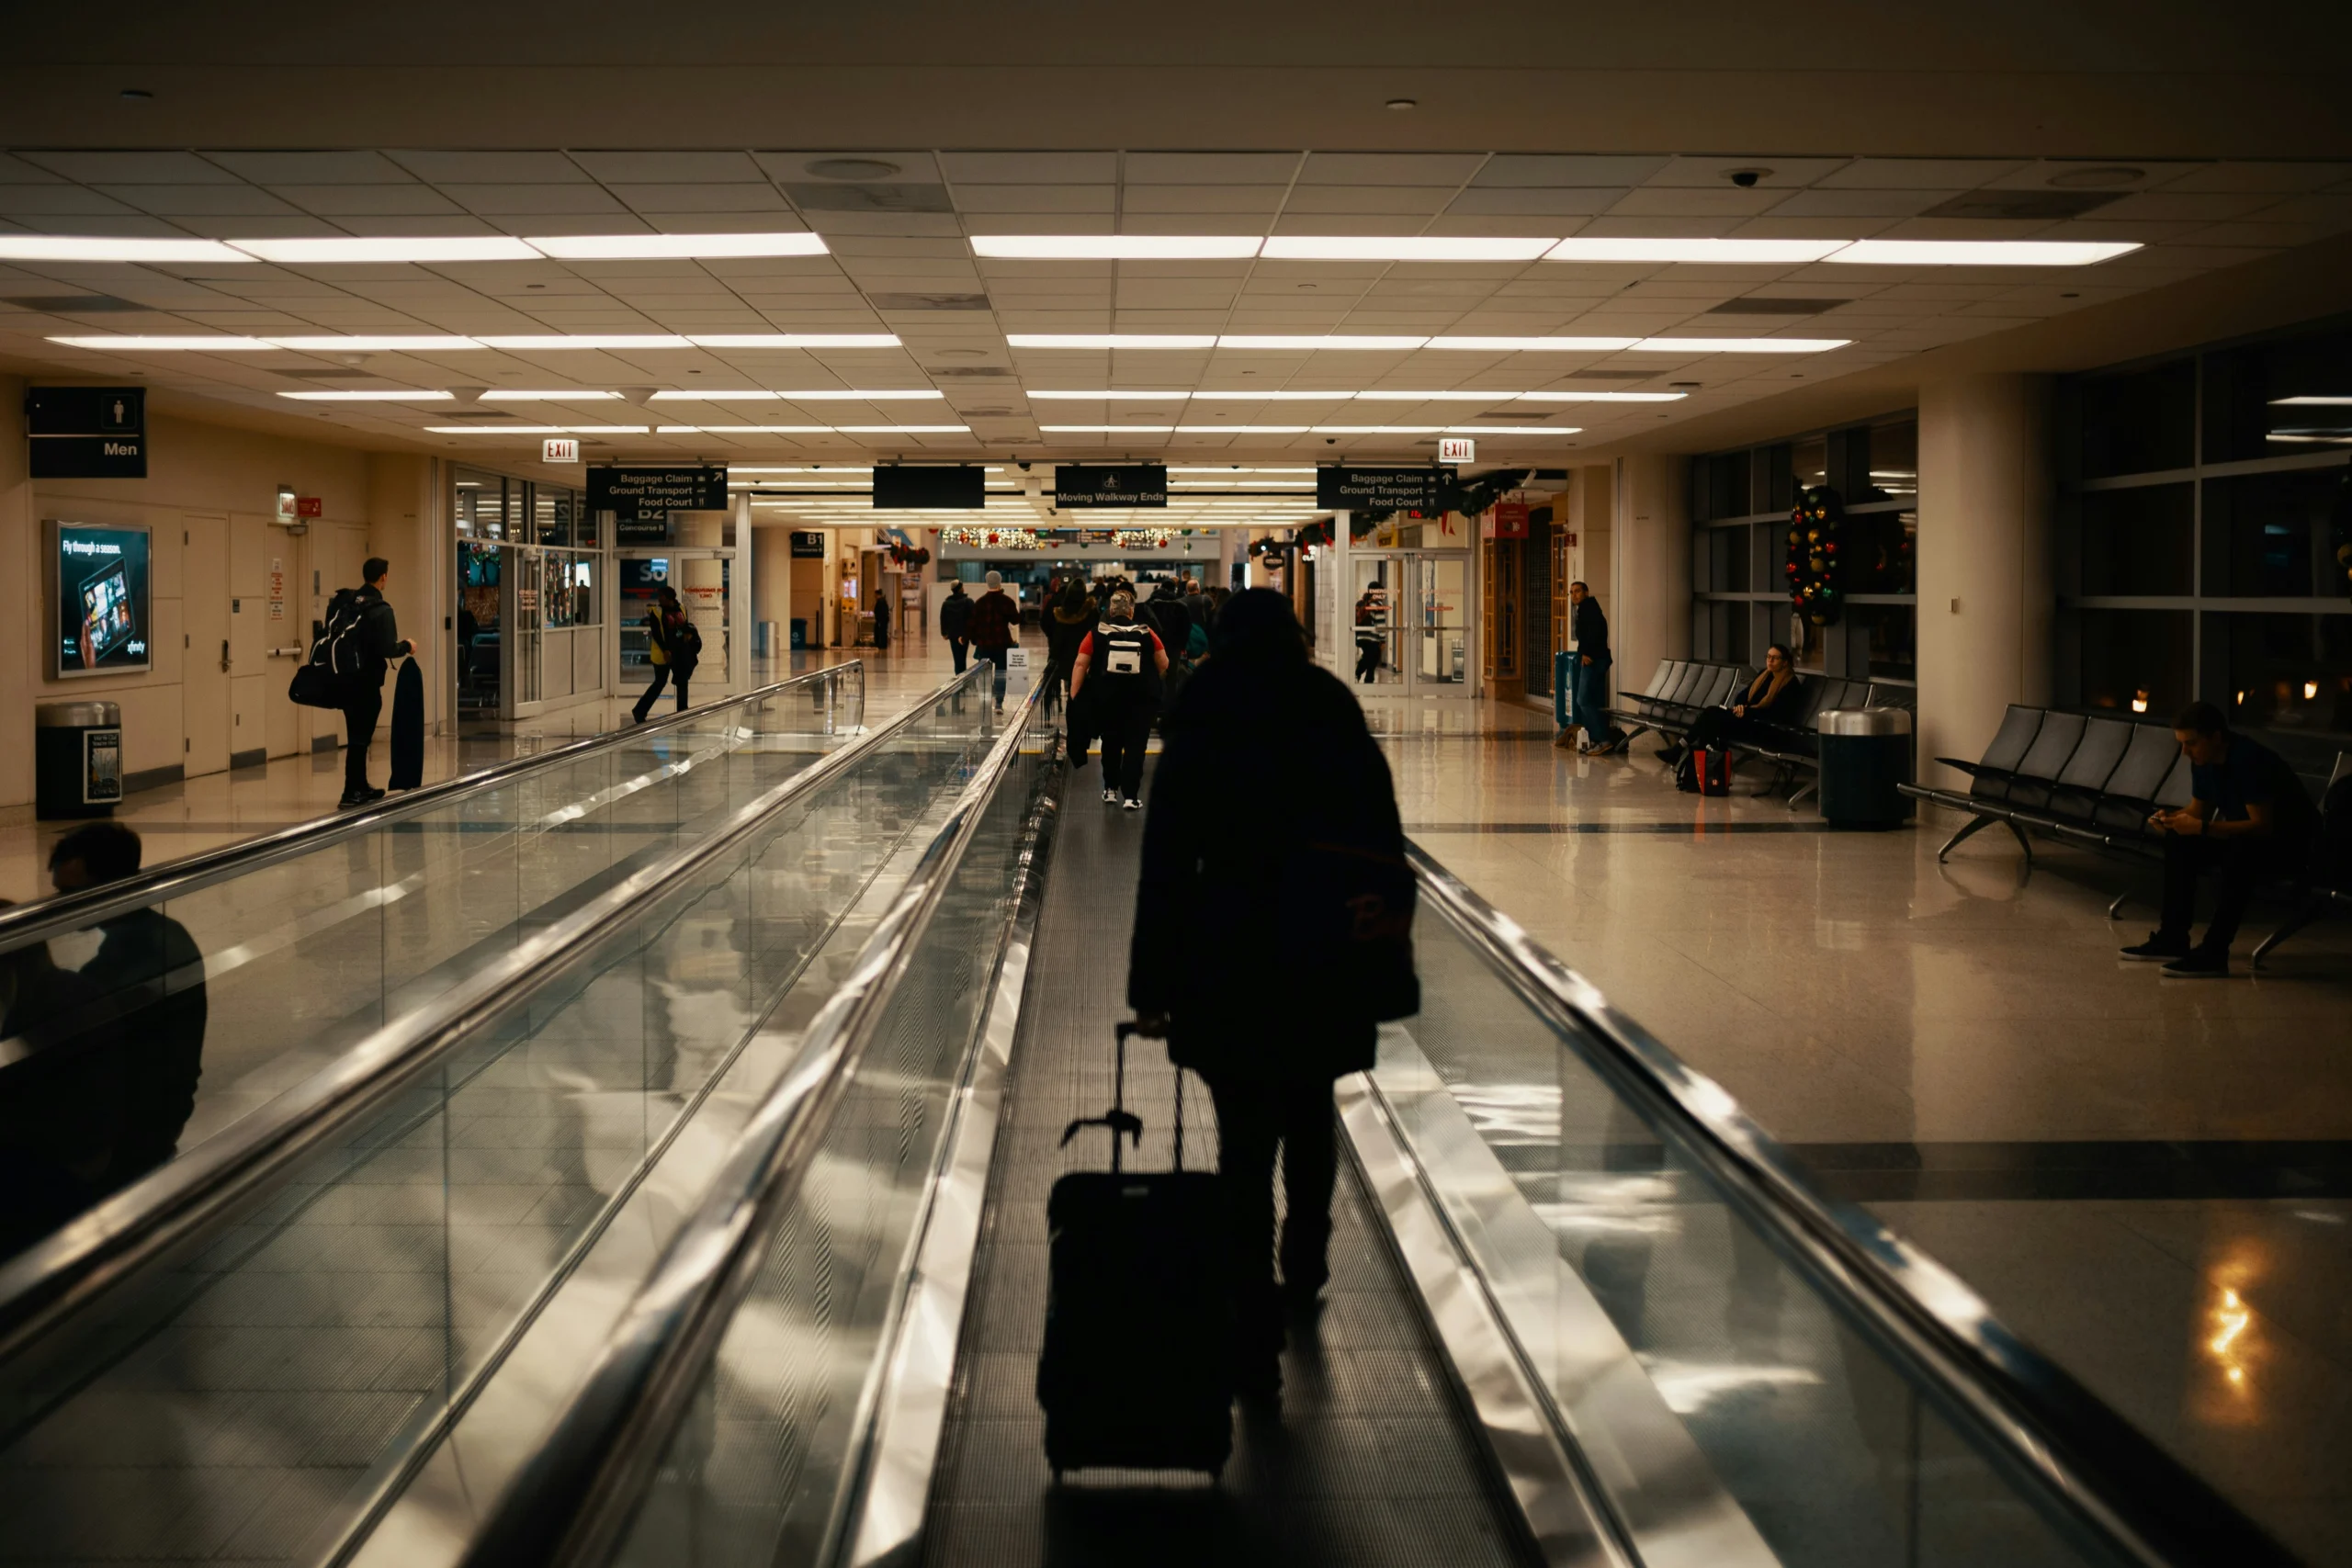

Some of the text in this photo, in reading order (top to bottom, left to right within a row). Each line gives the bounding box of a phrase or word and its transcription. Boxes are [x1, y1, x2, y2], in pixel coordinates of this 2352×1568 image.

[104, 442, 138, 456] Men
[548, 442, 573, 457] EXIT
[1444, 441, 1468, 457] EXIT
[620, 473, 693, 484] Baggage Claim
[1351, 473, 1423, 484] Baggage Claim
[609, 486, 693, 496] Ground Transport
[1340, 485, 1423, 496] Ground Transport
[639, 498, 693, 506] Food Court
[1057, 492, 1164, 503] Moving Walkway Ends
[1369, 497, 1423, 506] Food Court
[807, 534, 823, 545] B1
[62, 539, 72, 555] Fly
[73, 540, 96, 556] through
[96, 544, 100, 553] a
[127, 639, 145, 655] xfinity
